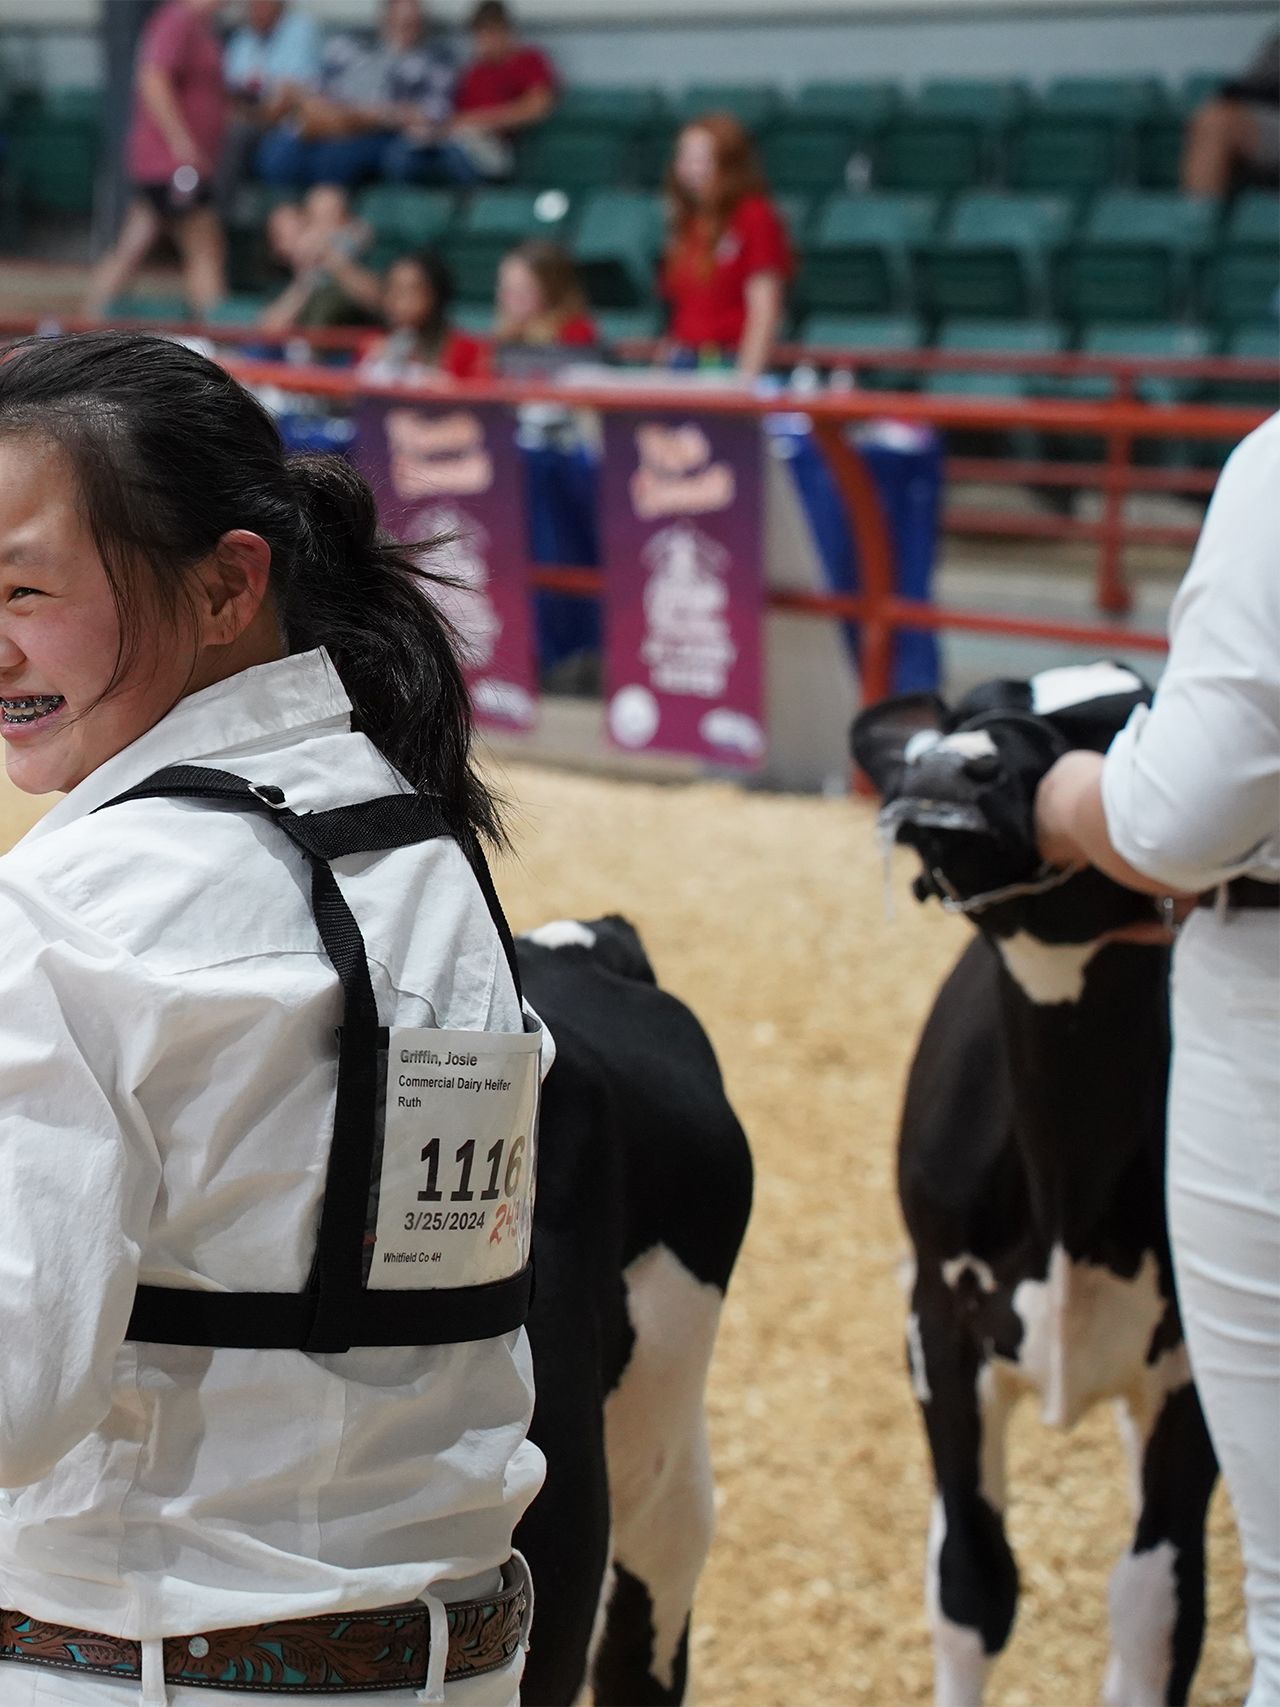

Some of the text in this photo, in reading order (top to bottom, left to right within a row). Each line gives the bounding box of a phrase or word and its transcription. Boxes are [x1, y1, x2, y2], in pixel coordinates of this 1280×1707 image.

[400, 1049, 478, 1066] Griffin, Josie
[398, 1075, 511, 1092] Commercial Dairy Heifer
[398, 1096, 422, 1108] Ruth
[417, 1136, 526, 1201] 1116
[404, 1211, 485, 1230] 3/25/2024
[383, 1252, 441, 1263] Whitfield Co 4H
